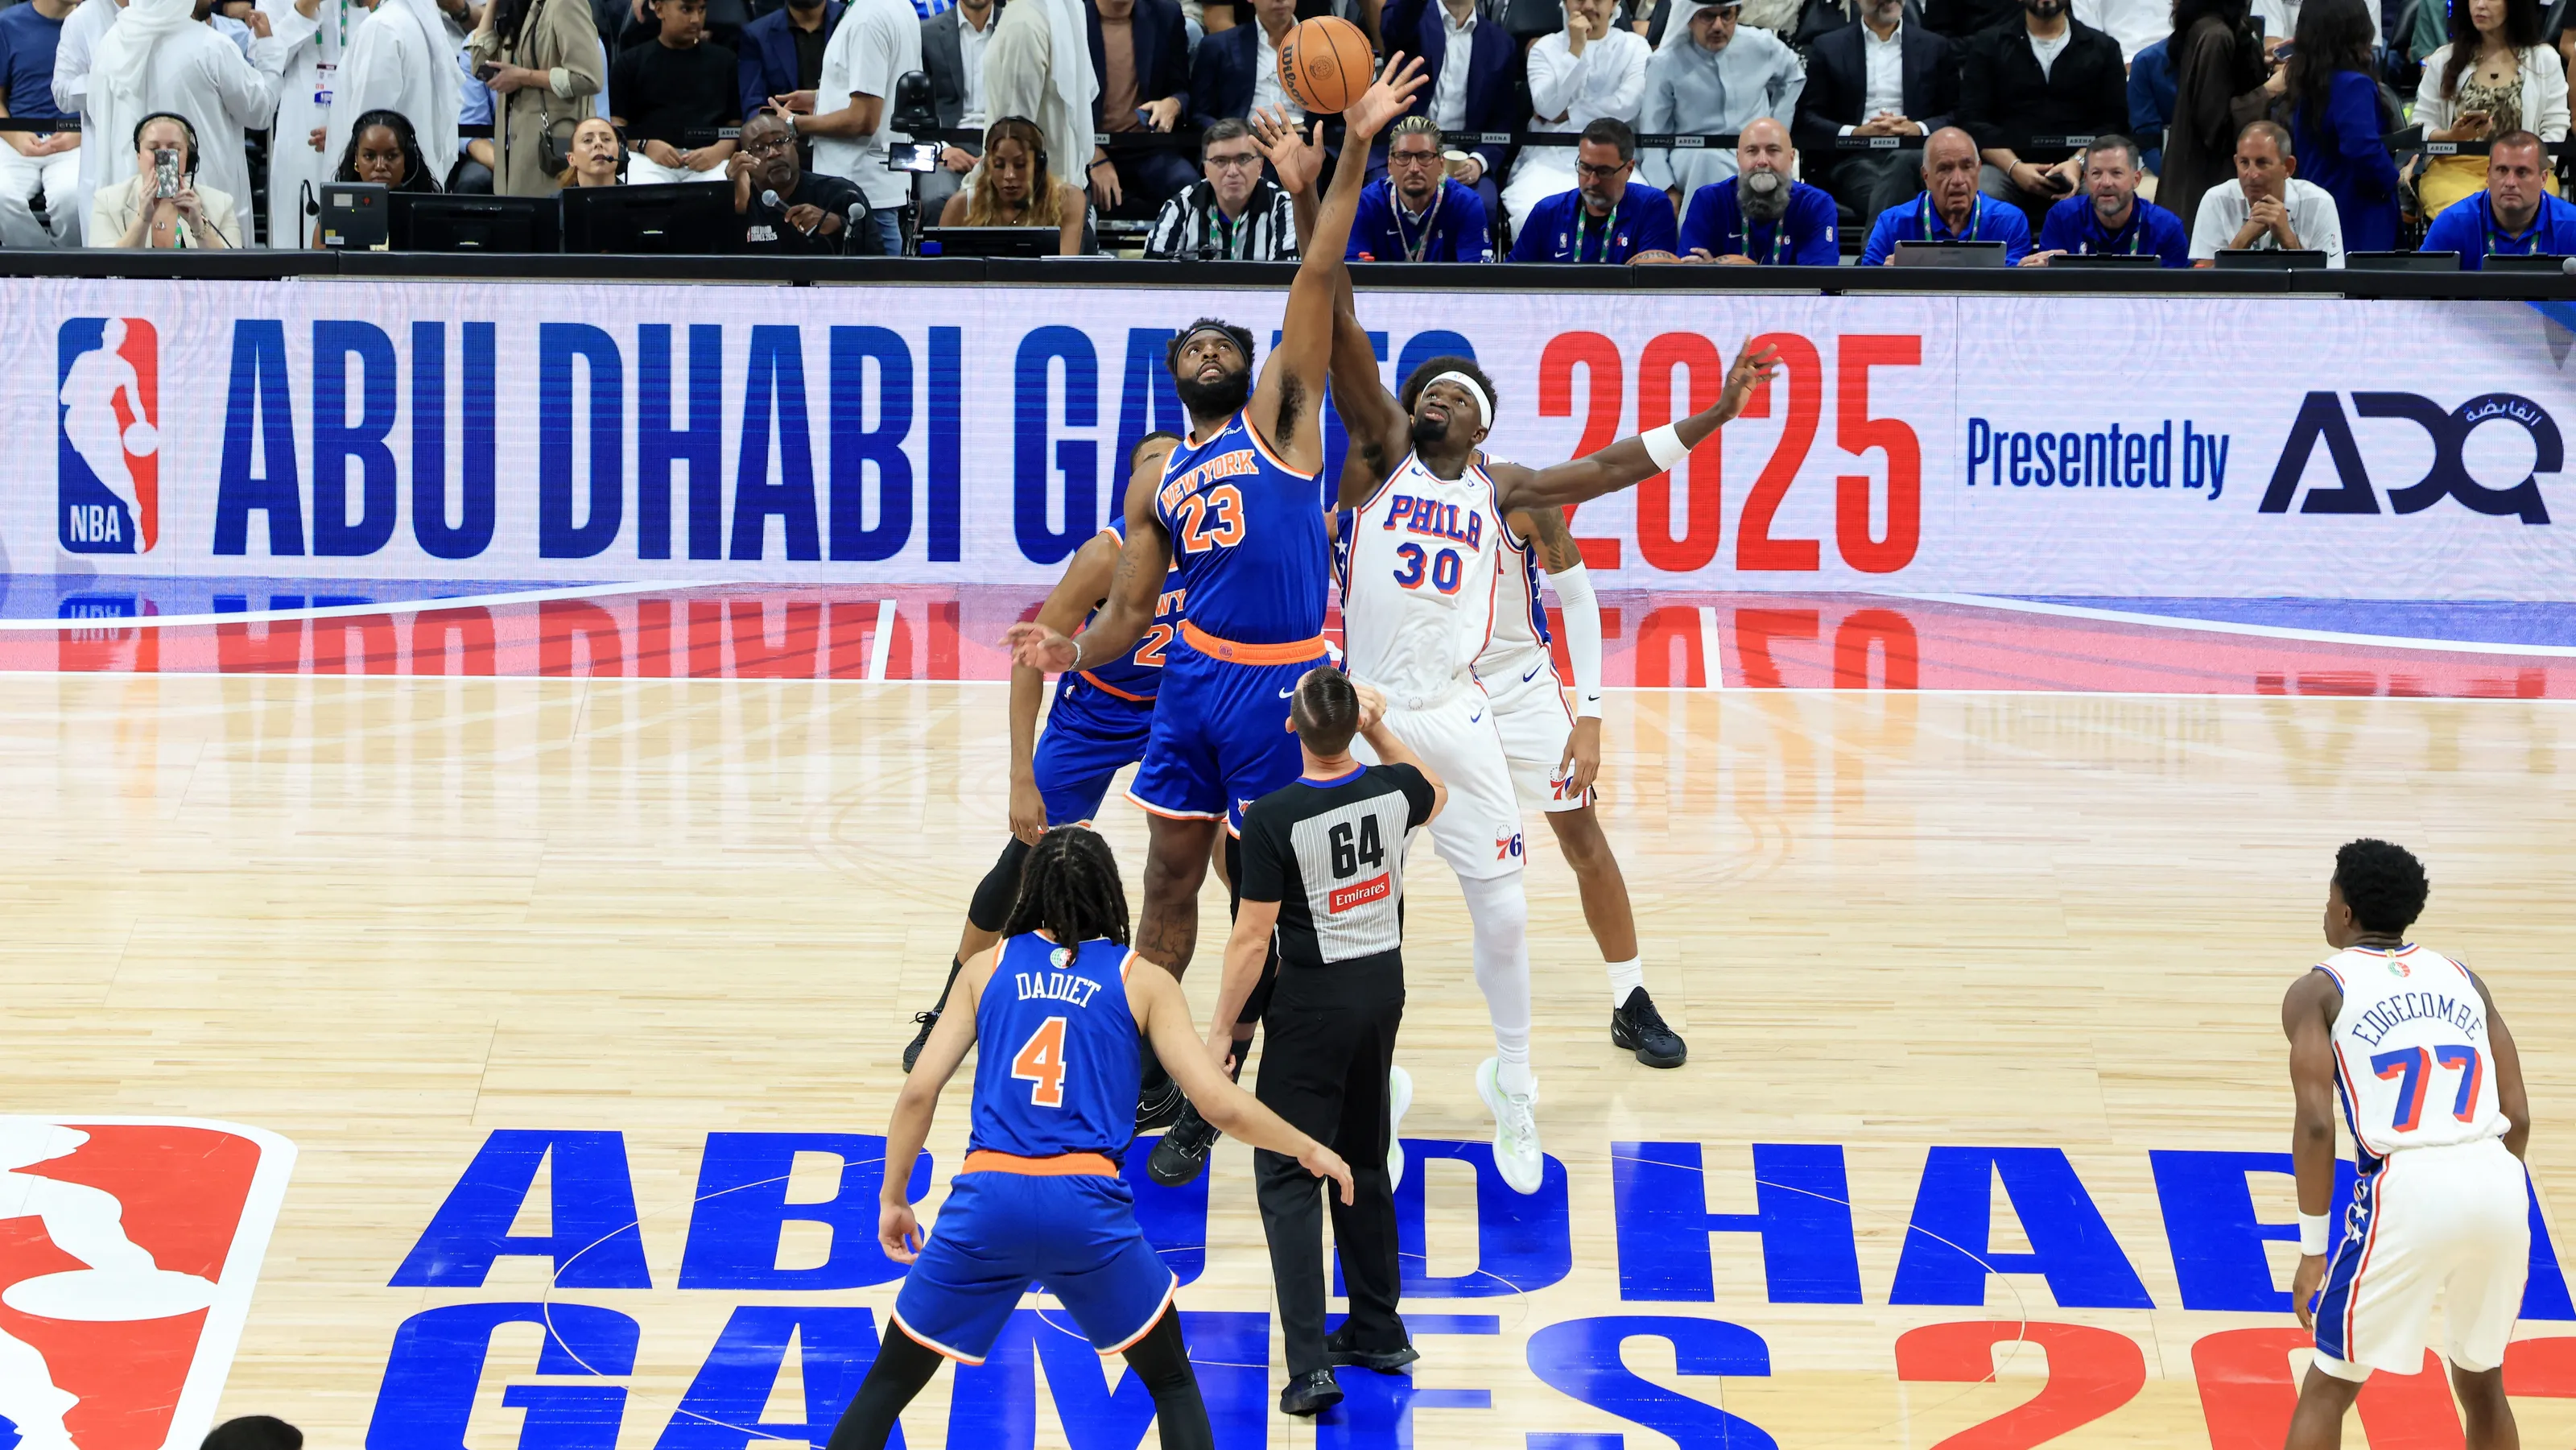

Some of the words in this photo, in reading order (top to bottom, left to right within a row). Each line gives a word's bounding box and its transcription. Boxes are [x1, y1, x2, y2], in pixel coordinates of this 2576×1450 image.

[2465, 400, 2543, 428] القابضة
[213, 319, 496, 559] ABU
[539, 322, 961, 562] DHABI
[1538, 331, 1922, 572] 2025
[1967, 418, 2171, 488] Presented
[2183, 420, 2229, 501] by
[2258, 390, 2564, 525] ADQ
[1160, 466, 1200, 515] NEW
[1198, 448, 1260, 485] YORK
[69, 505, 121, 543] NBA
[1177, 483, 1246, 554] 23
[1383, 494, 1483, 553] PHILA
[1393, 542, 1463, 595] 30
[1133, 618, 1187, 667] 2
[1328, 814, 1384, 879] 64
[1496, 832, 1522, 861] 76
[1335, 882, 1385, 906] Emirates
[1015, 972, 1102, 1008] DADIET
[2351, 992, 2483, 1047] EDGECOMBE
[1010, 1016, 1067, 1108] 4
[2370, 1044, 2483, 1133] 77
